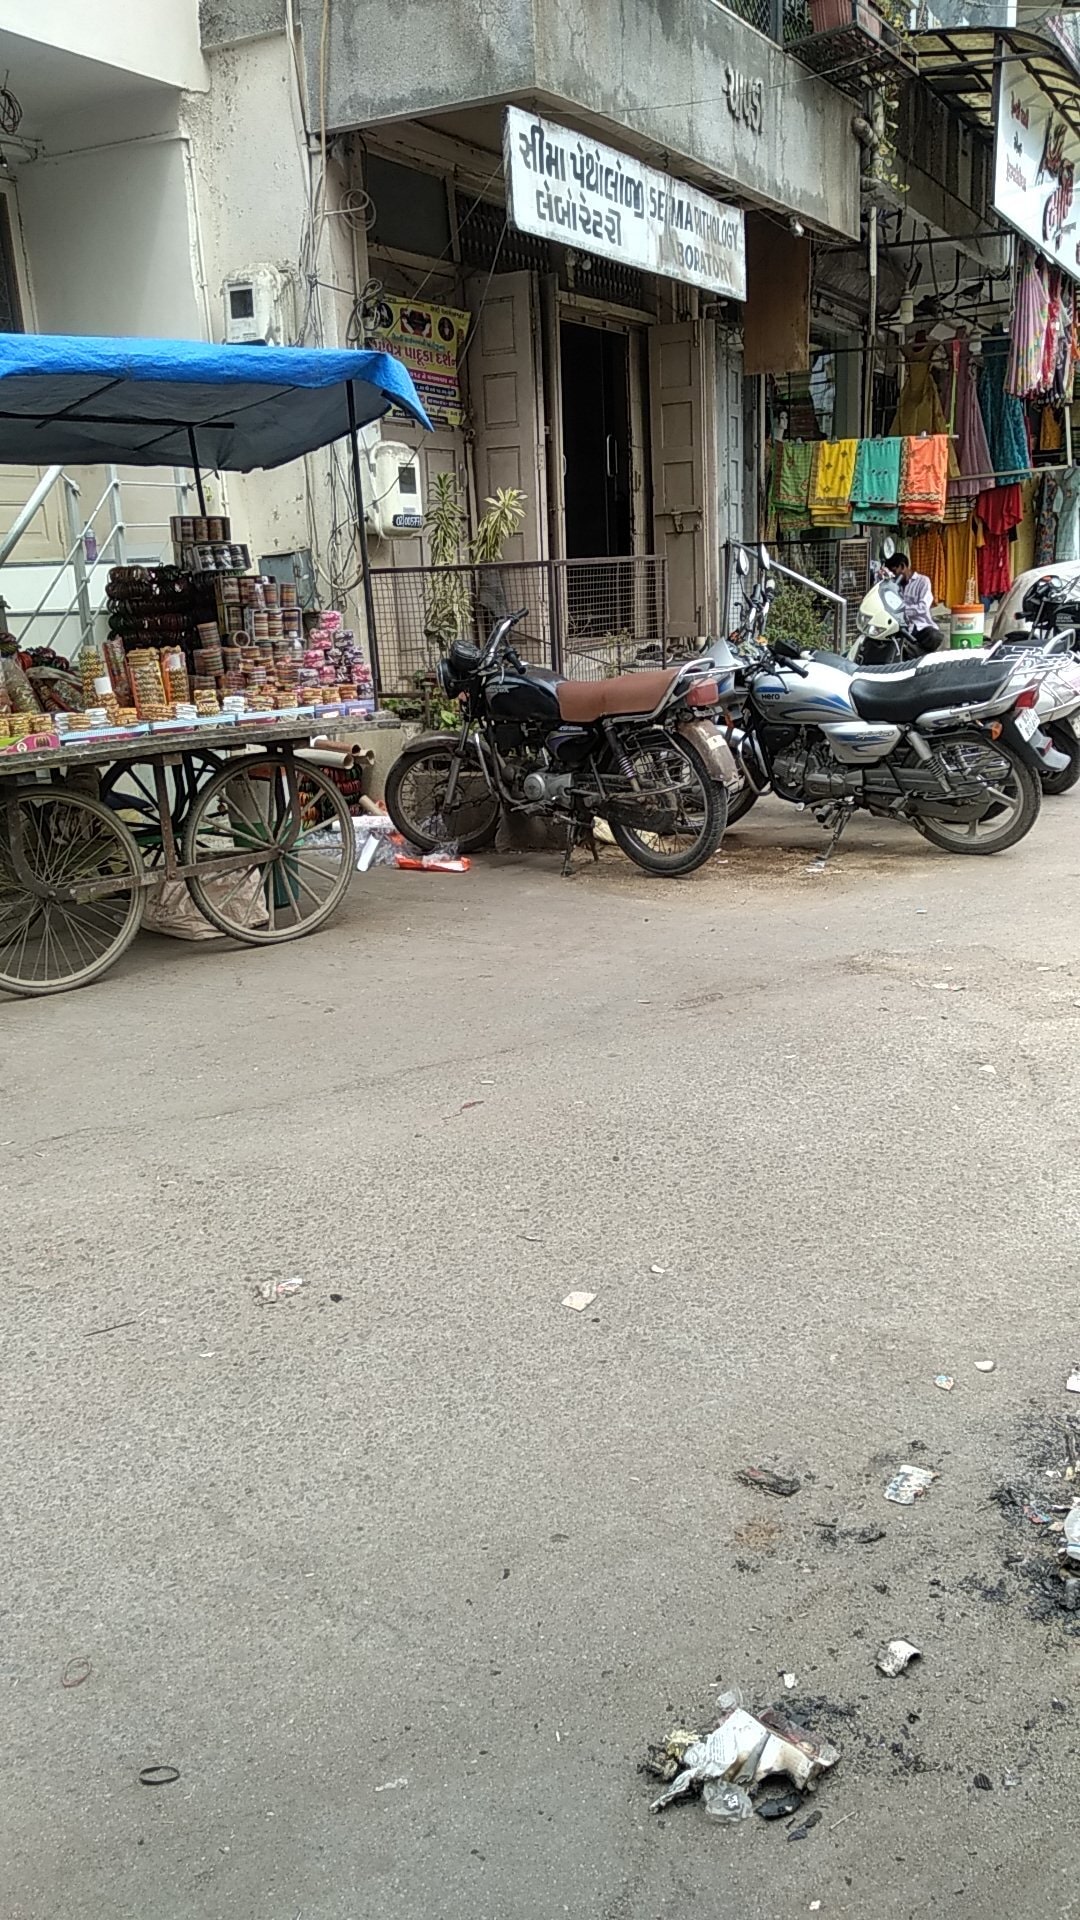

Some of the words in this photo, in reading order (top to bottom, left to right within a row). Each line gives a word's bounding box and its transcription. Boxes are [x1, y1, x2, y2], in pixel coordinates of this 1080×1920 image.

[519, 125, 567, 182] સીમા
[570, 142, 645, 219] પેથોલોજી
[536, 181, 622, 246] લેબોરેટરી
